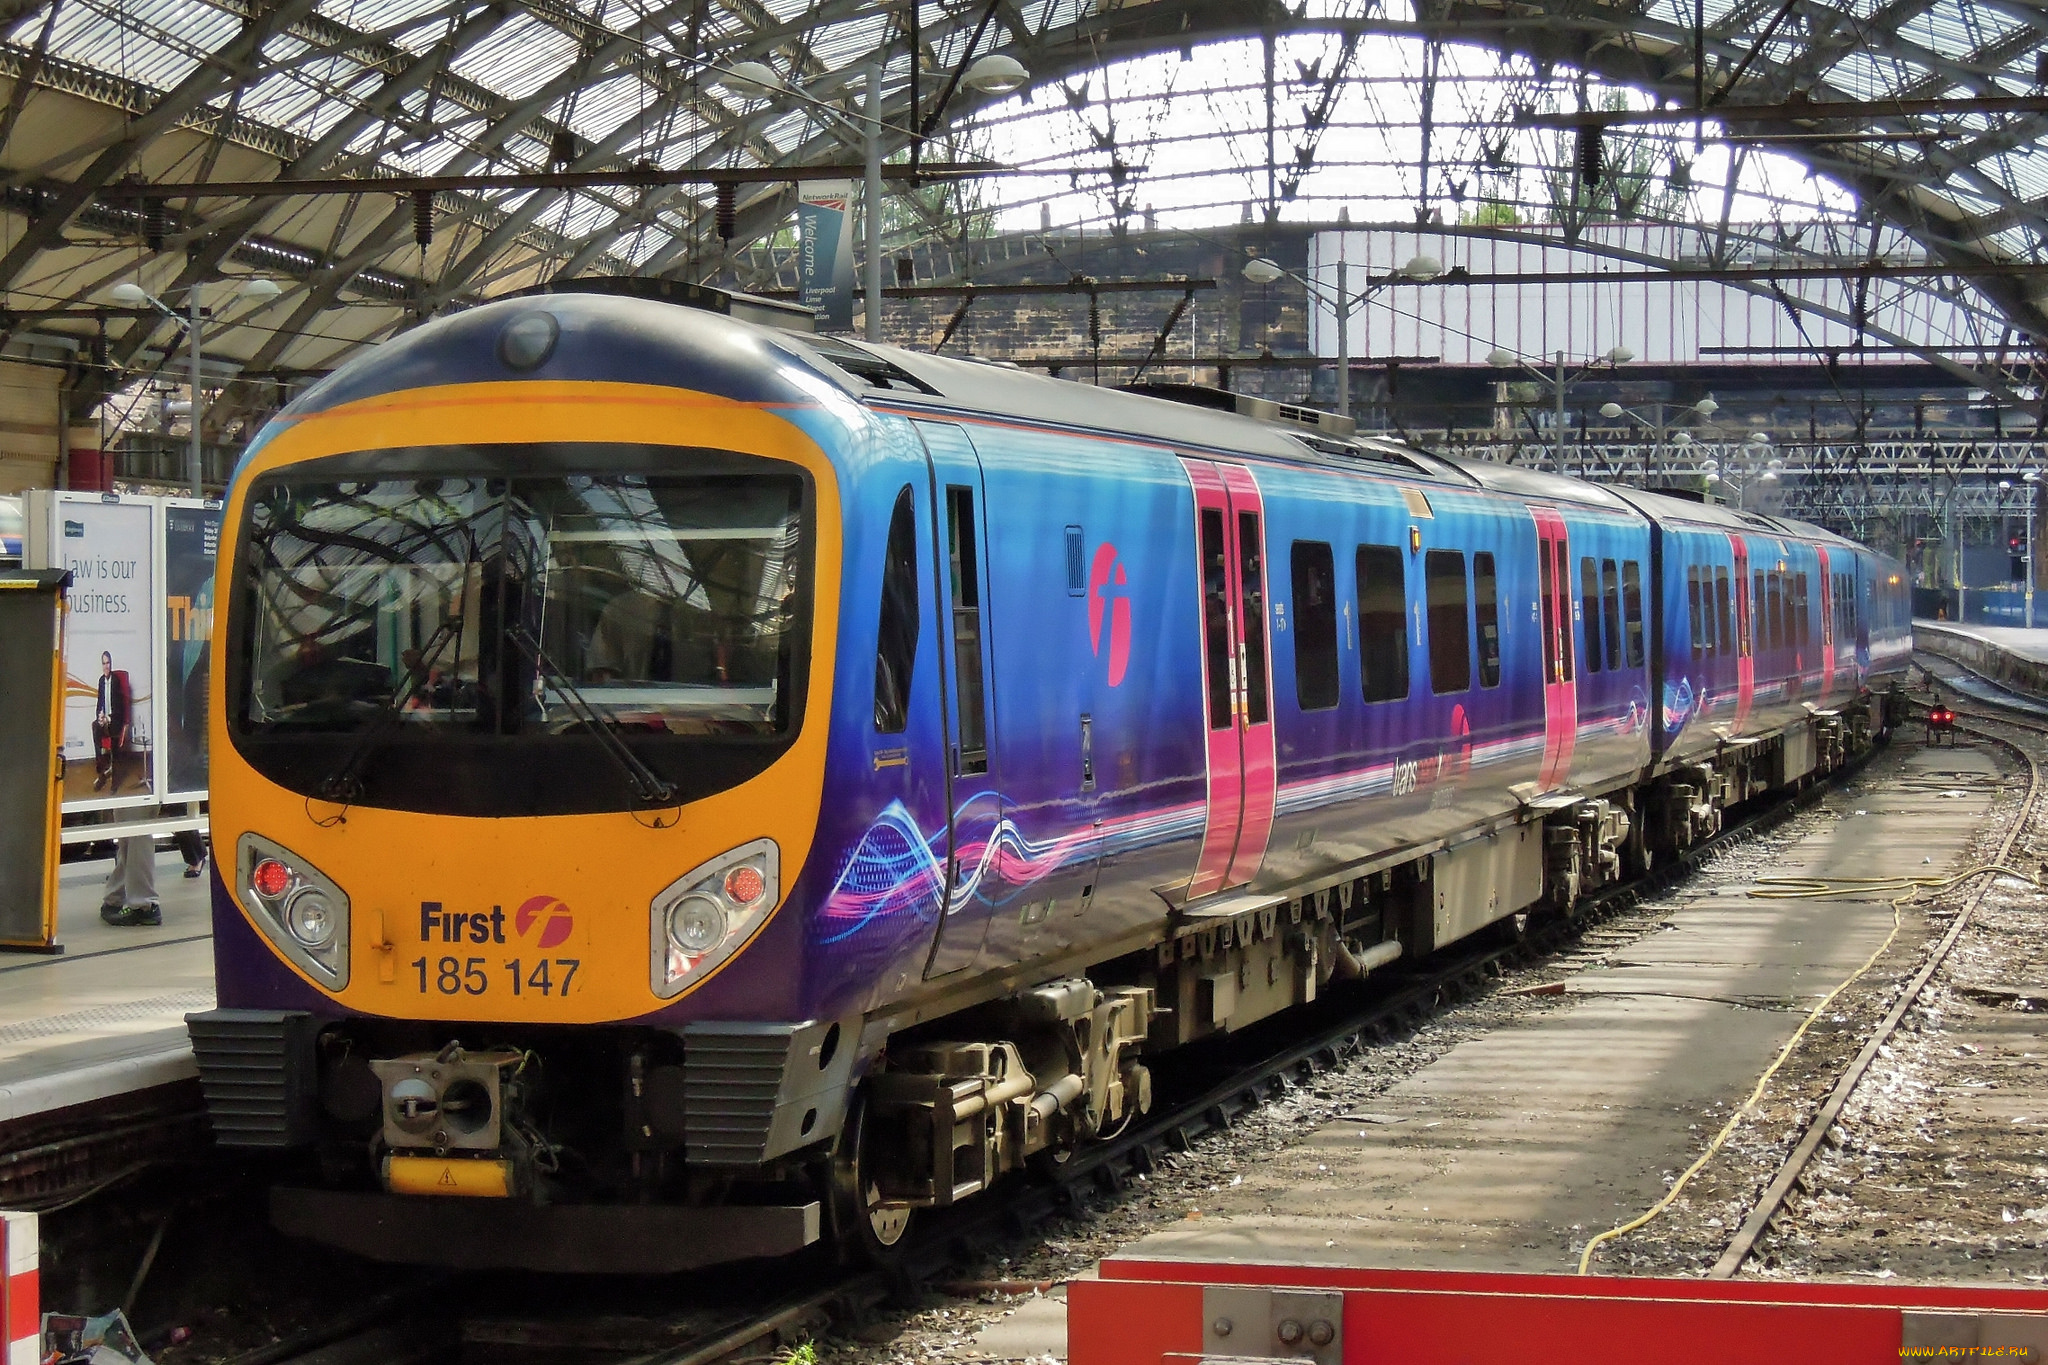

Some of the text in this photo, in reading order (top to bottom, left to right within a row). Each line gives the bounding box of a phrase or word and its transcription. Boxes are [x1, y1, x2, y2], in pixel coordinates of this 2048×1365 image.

[804, 214, 817, 276] Welcome
[805, 286, 836, 295] Liverpool
[97, 554, 108, 579] is
[111, 559, 137, 579] our
[420, 901, 506, 944] First
[411, 956, 581, 996] 185 147
